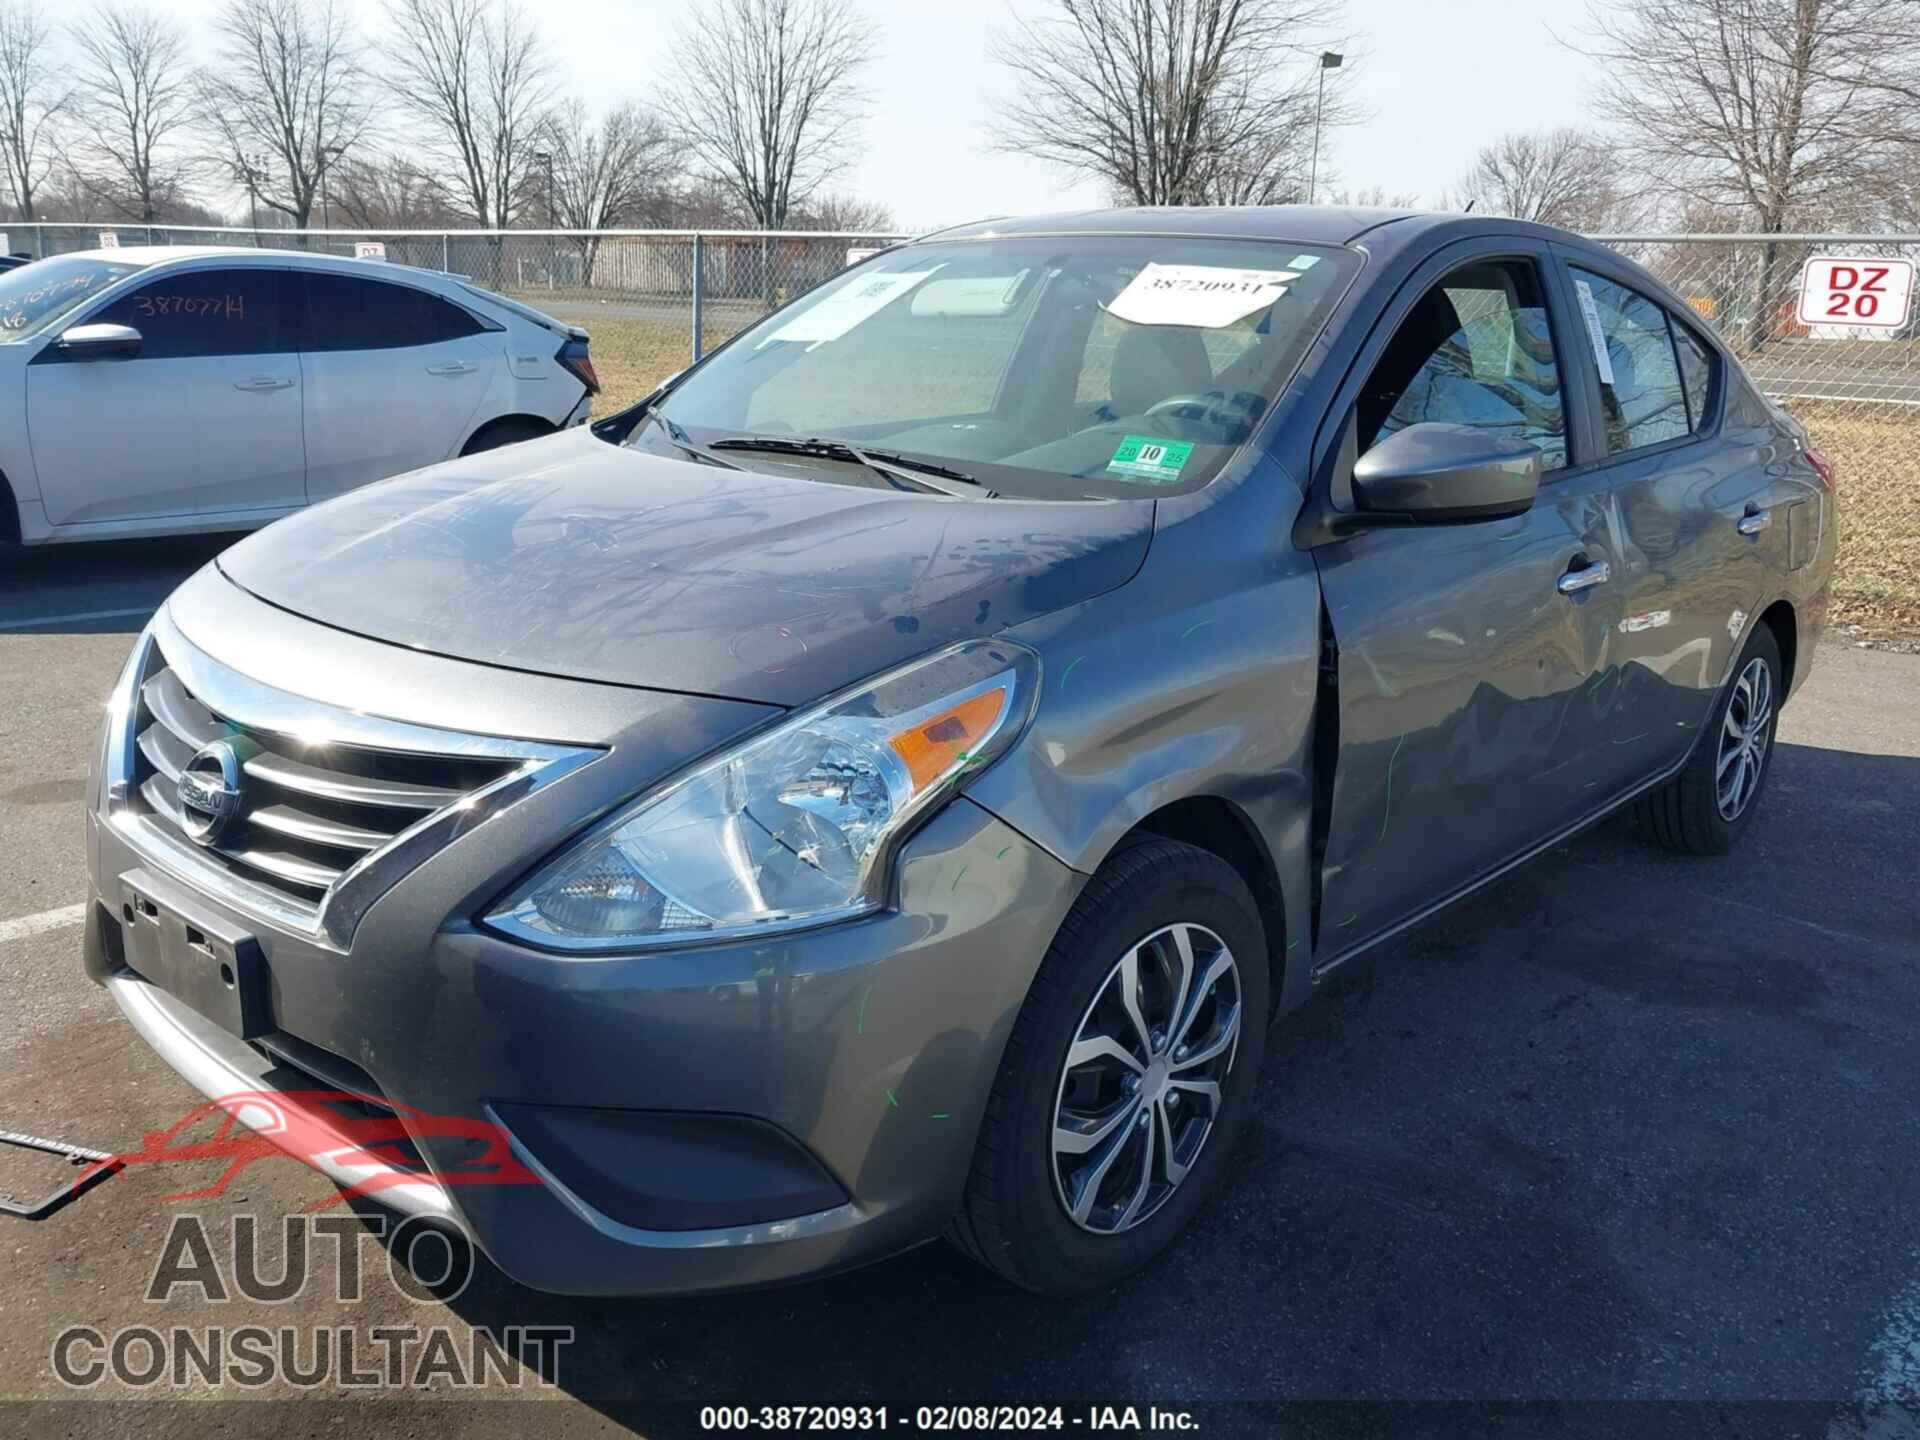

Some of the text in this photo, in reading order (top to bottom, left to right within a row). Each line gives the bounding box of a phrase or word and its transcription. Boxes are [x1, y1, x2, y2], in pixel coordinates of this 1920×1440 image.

[1144, 279, 1263, 295] 38720931
[1829, 266, 1889, 292] DZ
[1826, 292, 1878, 317] 20
[1141, 446, 1161, 460] 10
